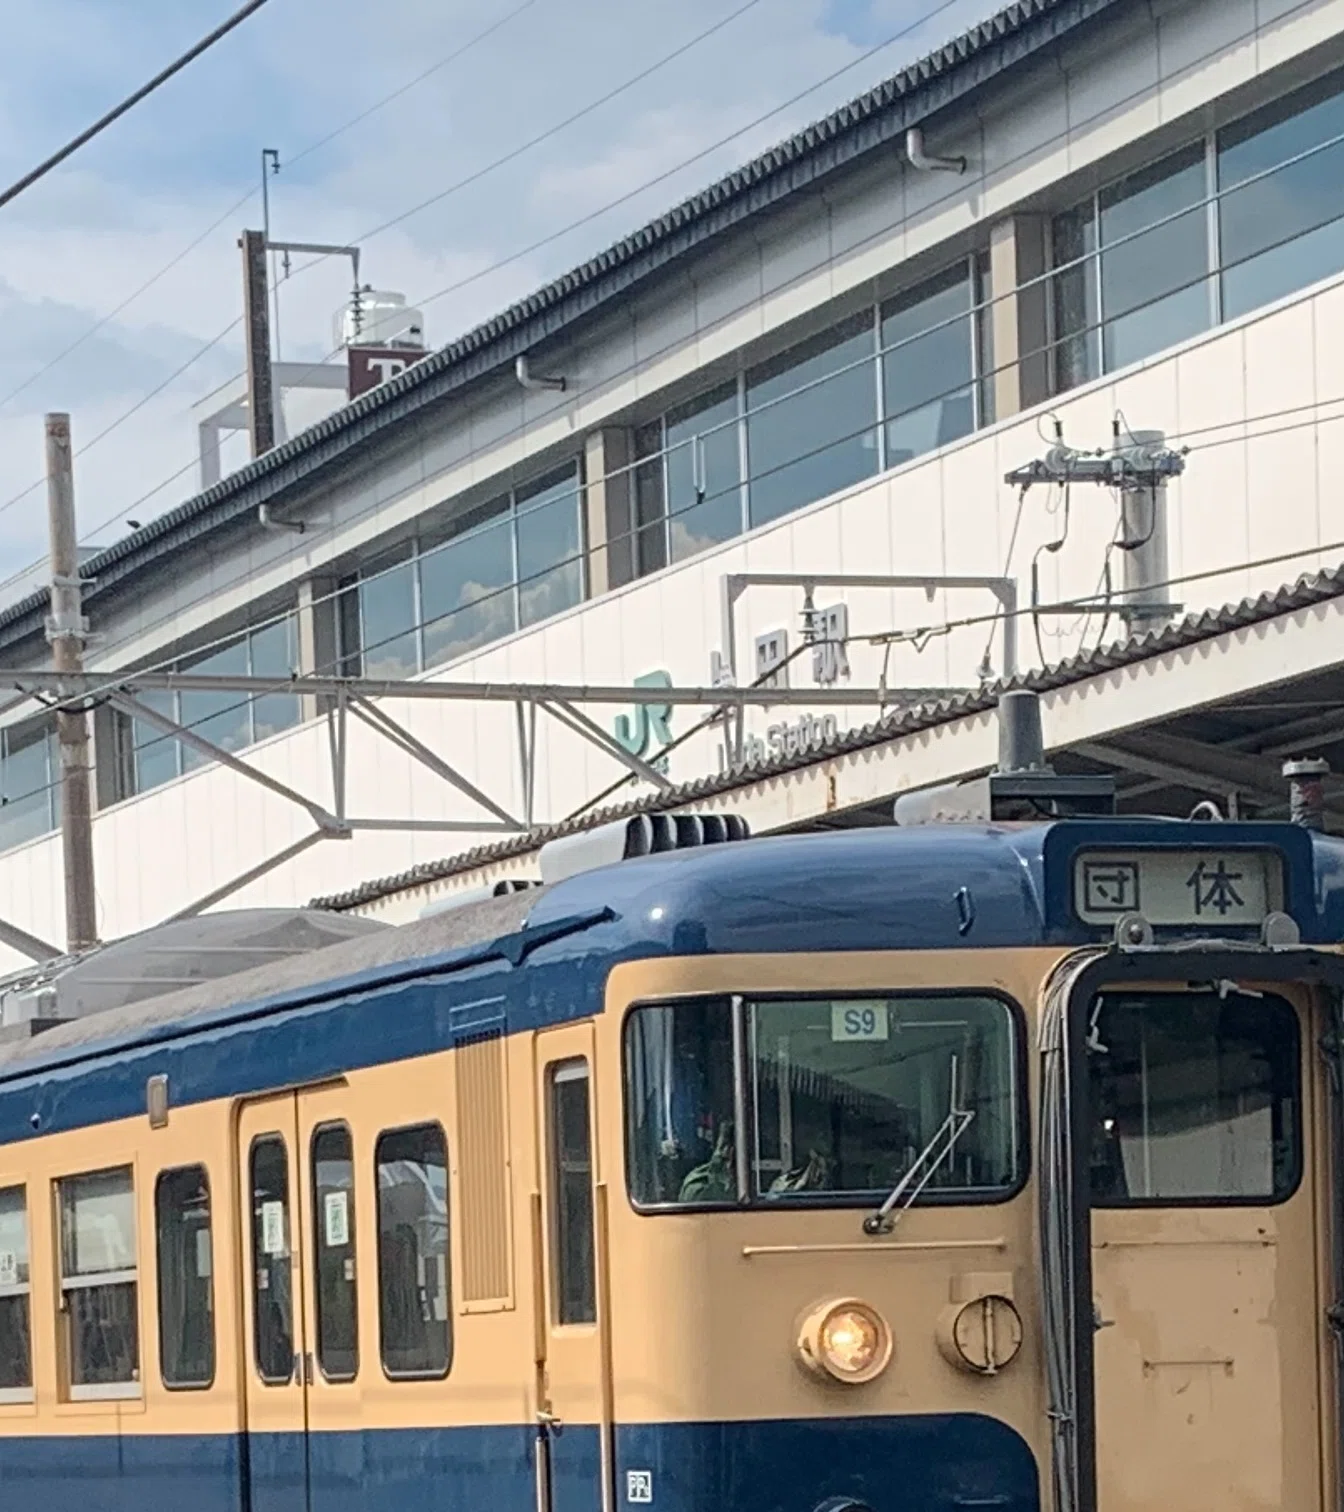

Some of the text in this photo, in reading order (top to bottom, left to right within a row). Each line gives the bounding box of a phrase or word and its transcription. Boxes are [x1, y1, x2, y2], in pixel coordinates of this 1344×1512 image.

[614, 670, 674, 757] JR
[1083, 860, 1245, 915] 団体
[844, 1008, 876, 1035] S9
